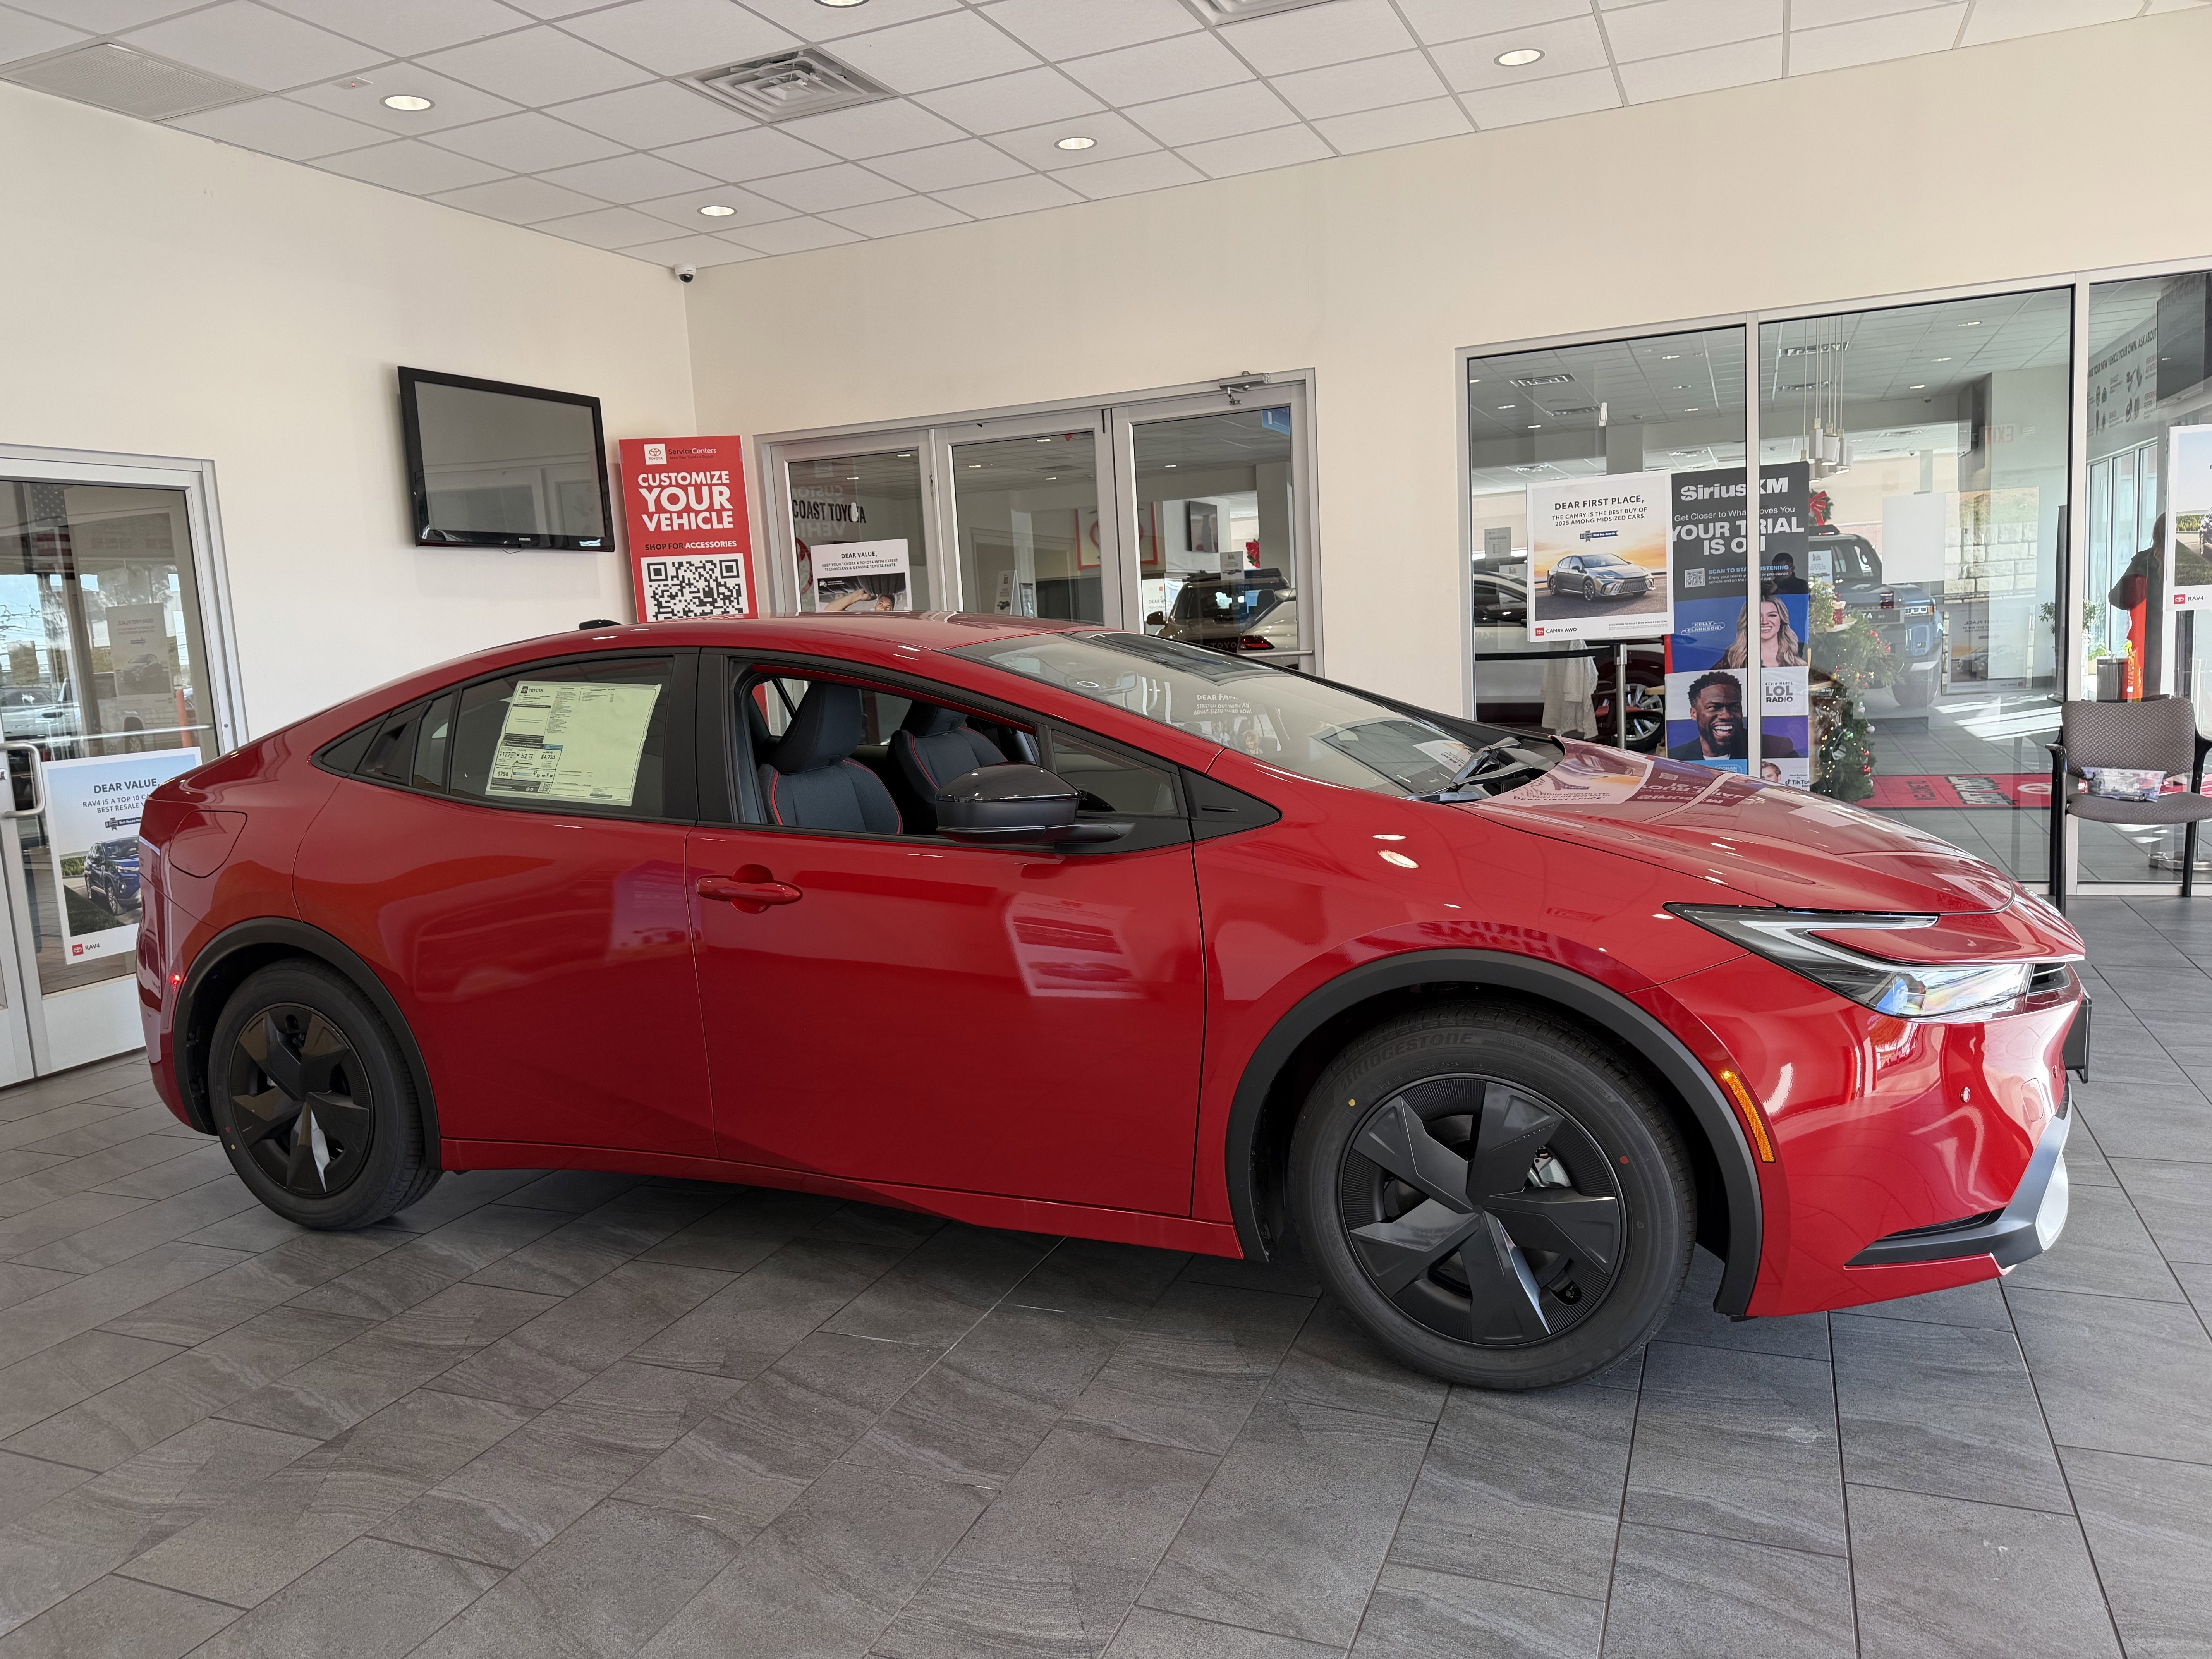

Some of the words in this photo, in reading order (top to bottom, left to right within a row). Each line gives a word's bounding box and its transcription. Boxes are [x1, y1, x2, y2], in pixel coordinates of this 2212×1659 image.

[638, 471, 730, 486] CUSTOMIZE
[638, 485, 733, 512] YOUR
[1554, 501, 1580, 510] DEAR
[1583, 498, 1608, 508] FIRST
[1611, 495, 1645, 505] PLACE,
[792, 500, 826, 520] COAST
[1691, 512, 1716, 520] Closer
[641, 511, 734, 531] VEHICLE
[1672, 522, 1730, 542] YOUR
[685, 540, 737, 549] ACCESSORIES
[1704, 539, 1725, 555] IS
[1766, 685, 1793, 696] LOL
[93, 782, 122, 793] DEAR
[124, 778, 160, 790] VALUE,
[115, 802, 139, 811] RESALE
[85, 943, 101, 951] RAV4
[1338, 1032, 1473, 1091] BRIDGESTONE
